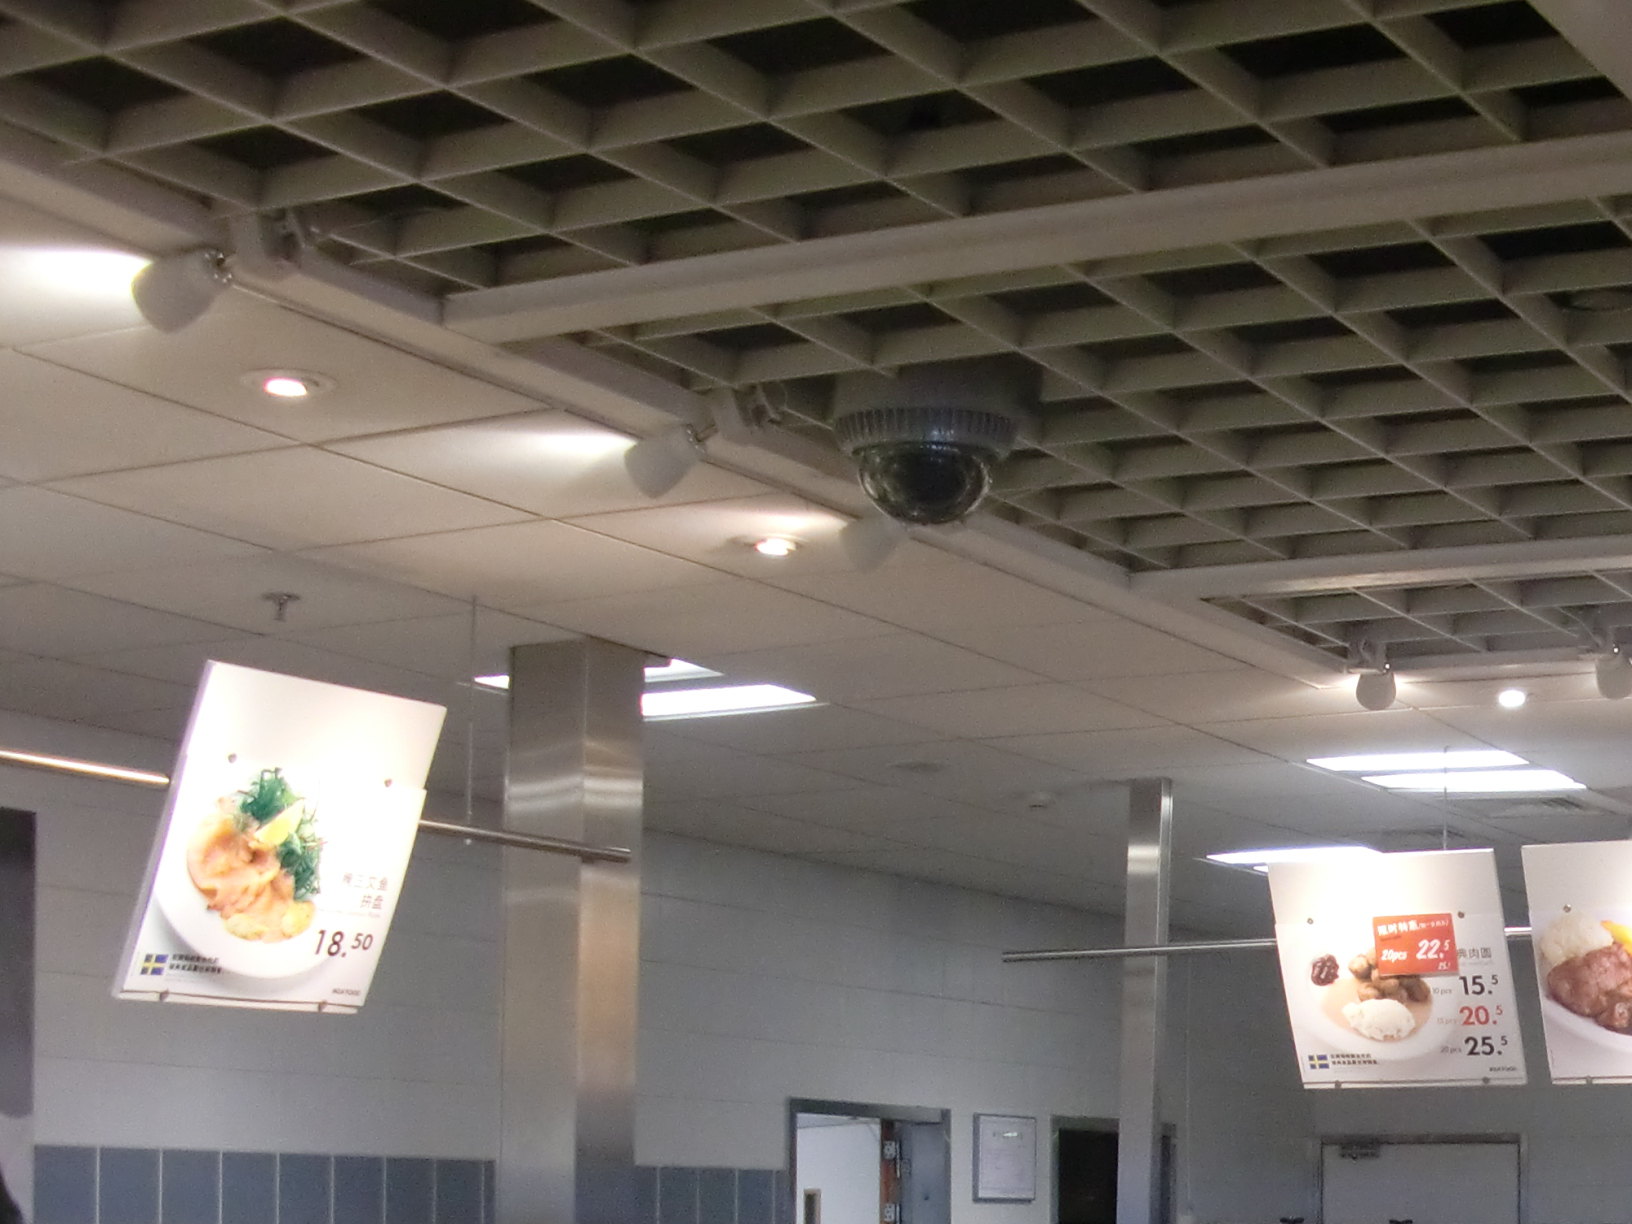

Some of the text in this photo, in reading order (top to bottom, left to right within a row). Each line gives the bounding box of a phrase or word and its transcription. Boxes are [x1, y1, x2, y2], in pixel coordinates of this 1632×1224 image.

[315, 929, 373, 957] 18.50
[1416, 939, 1450, 959] 22.5
[1459, 974, 1499, 995] 15.5
[1459, 1005, 1503, 1025] 20.5
[1464, 1035, 1508, 1056] 25.5
